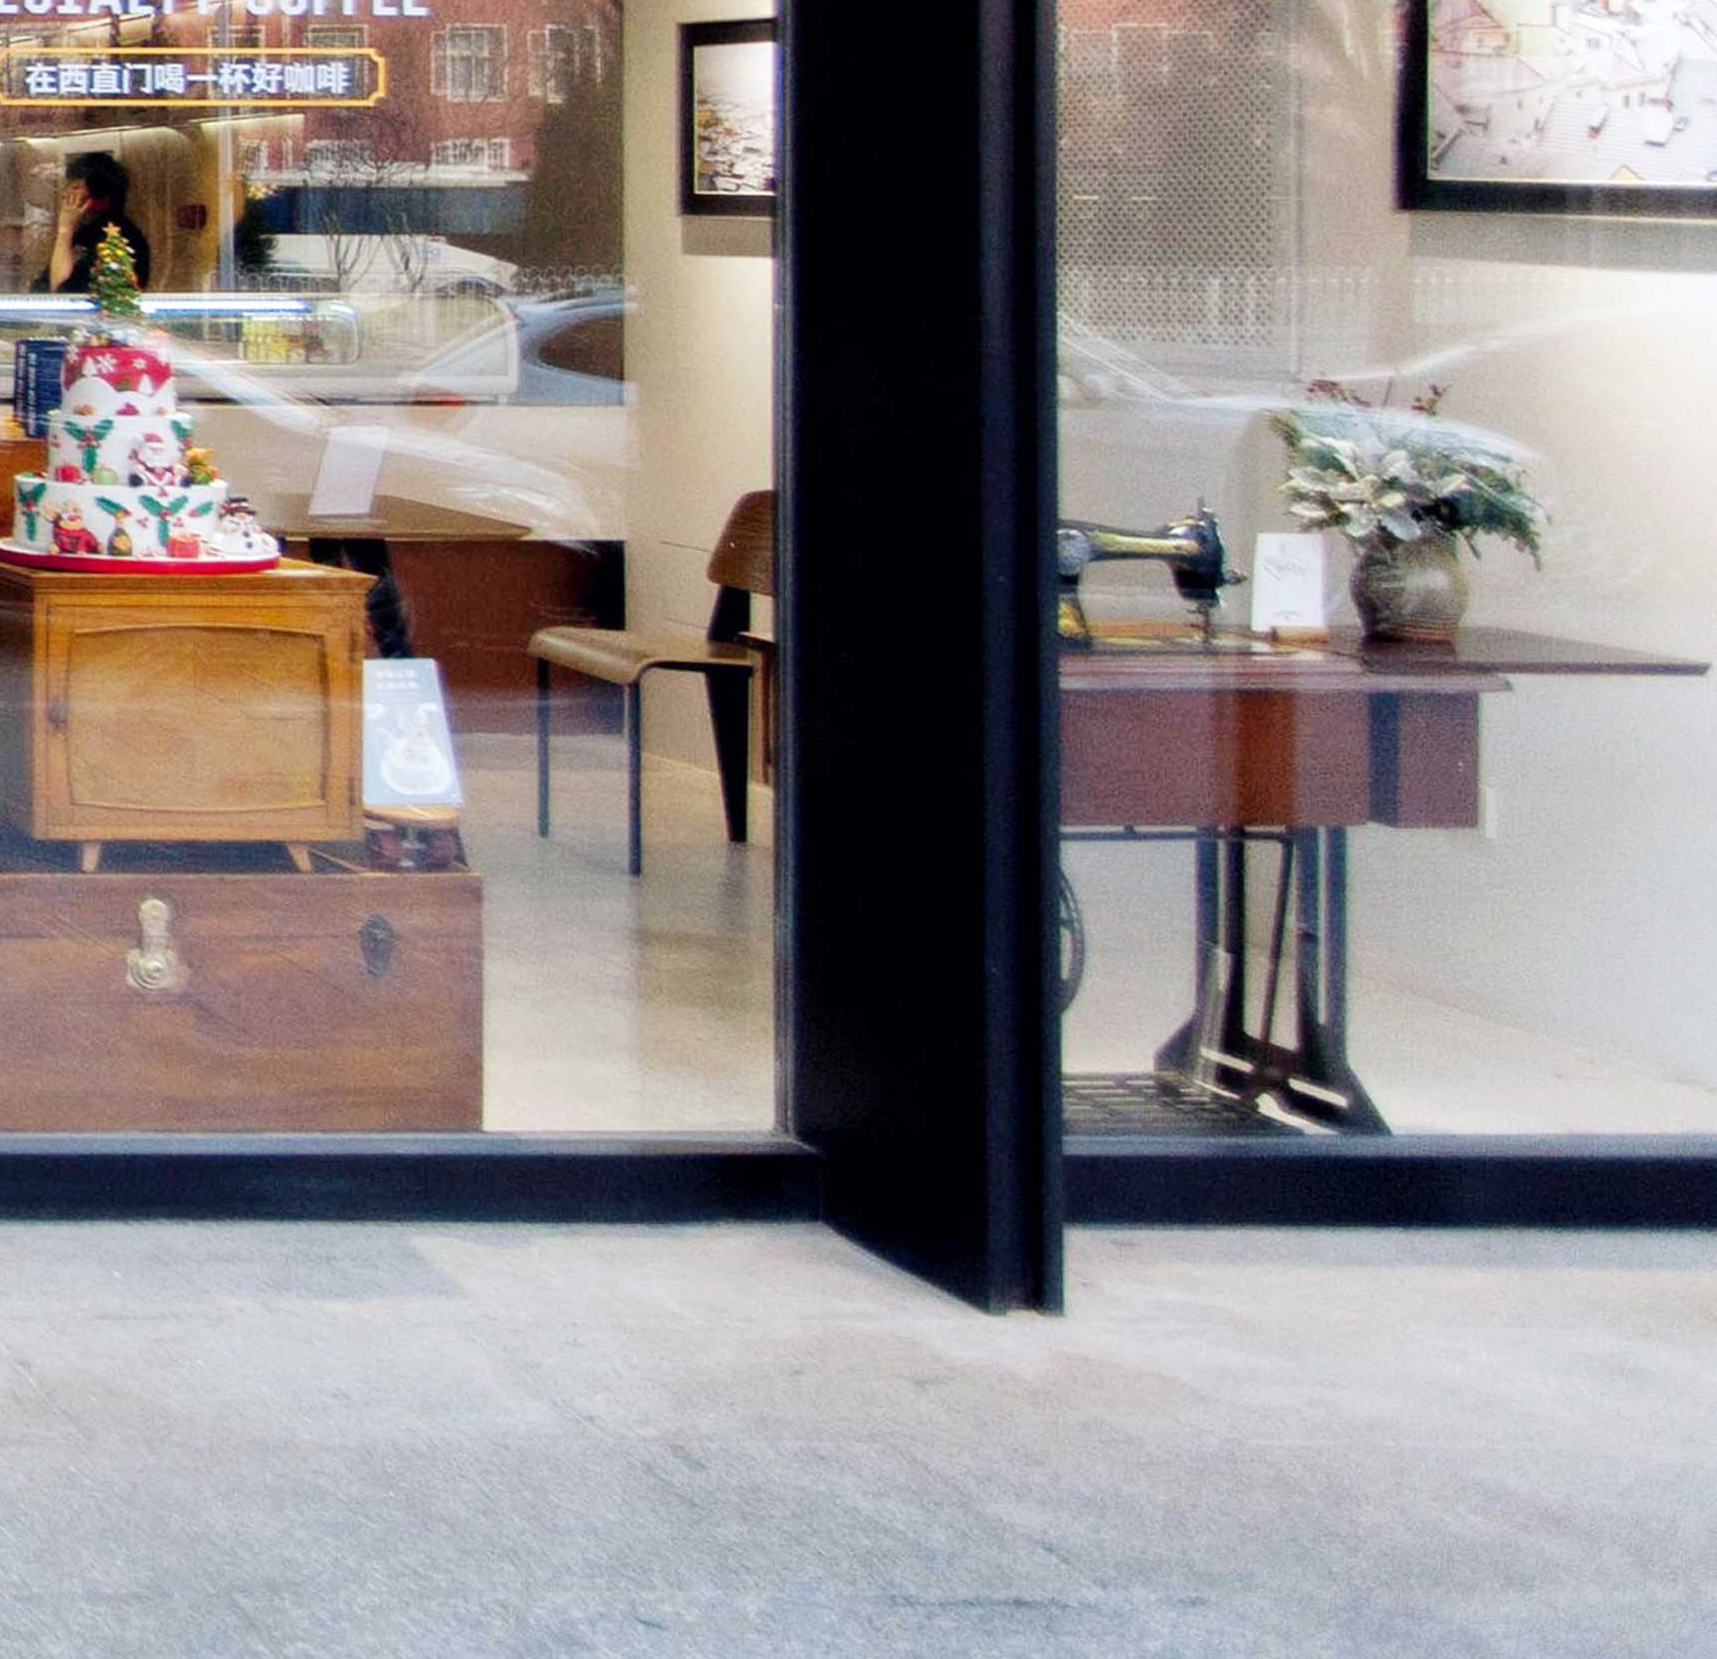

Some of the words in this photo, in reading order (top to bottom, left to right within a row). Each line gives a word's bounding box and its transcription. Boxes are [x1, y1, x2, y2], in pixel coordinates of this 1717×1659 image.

[25, 61, 352, 96] 在西直门喝一杯好咖啡
